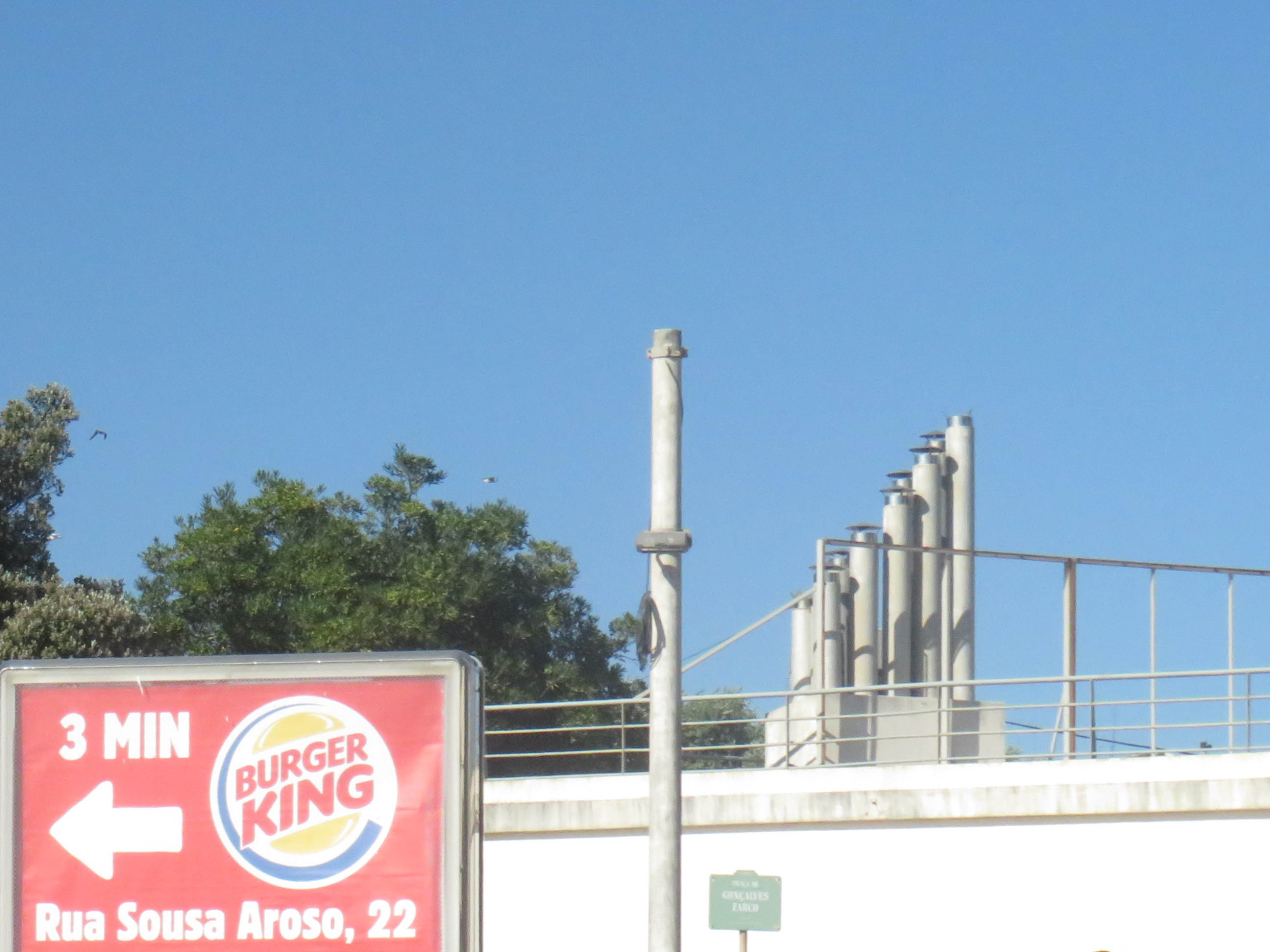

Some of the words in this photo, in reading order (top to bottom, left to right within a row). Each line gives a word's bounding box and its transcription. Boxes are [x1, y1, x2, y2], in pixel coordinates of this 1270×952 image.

[59, 712, 87, 761] 3
[103, 711, 190, 760] MIN
[236, 732, 368, 801] BURGER
[240, 764, 375, 849] KING
[35, 903, 105, 942] Rua
[117, 902, 225, 942] Sousa
[237, 901, 355, 945] Aroso,
[367, 900, 418, 939] 22
